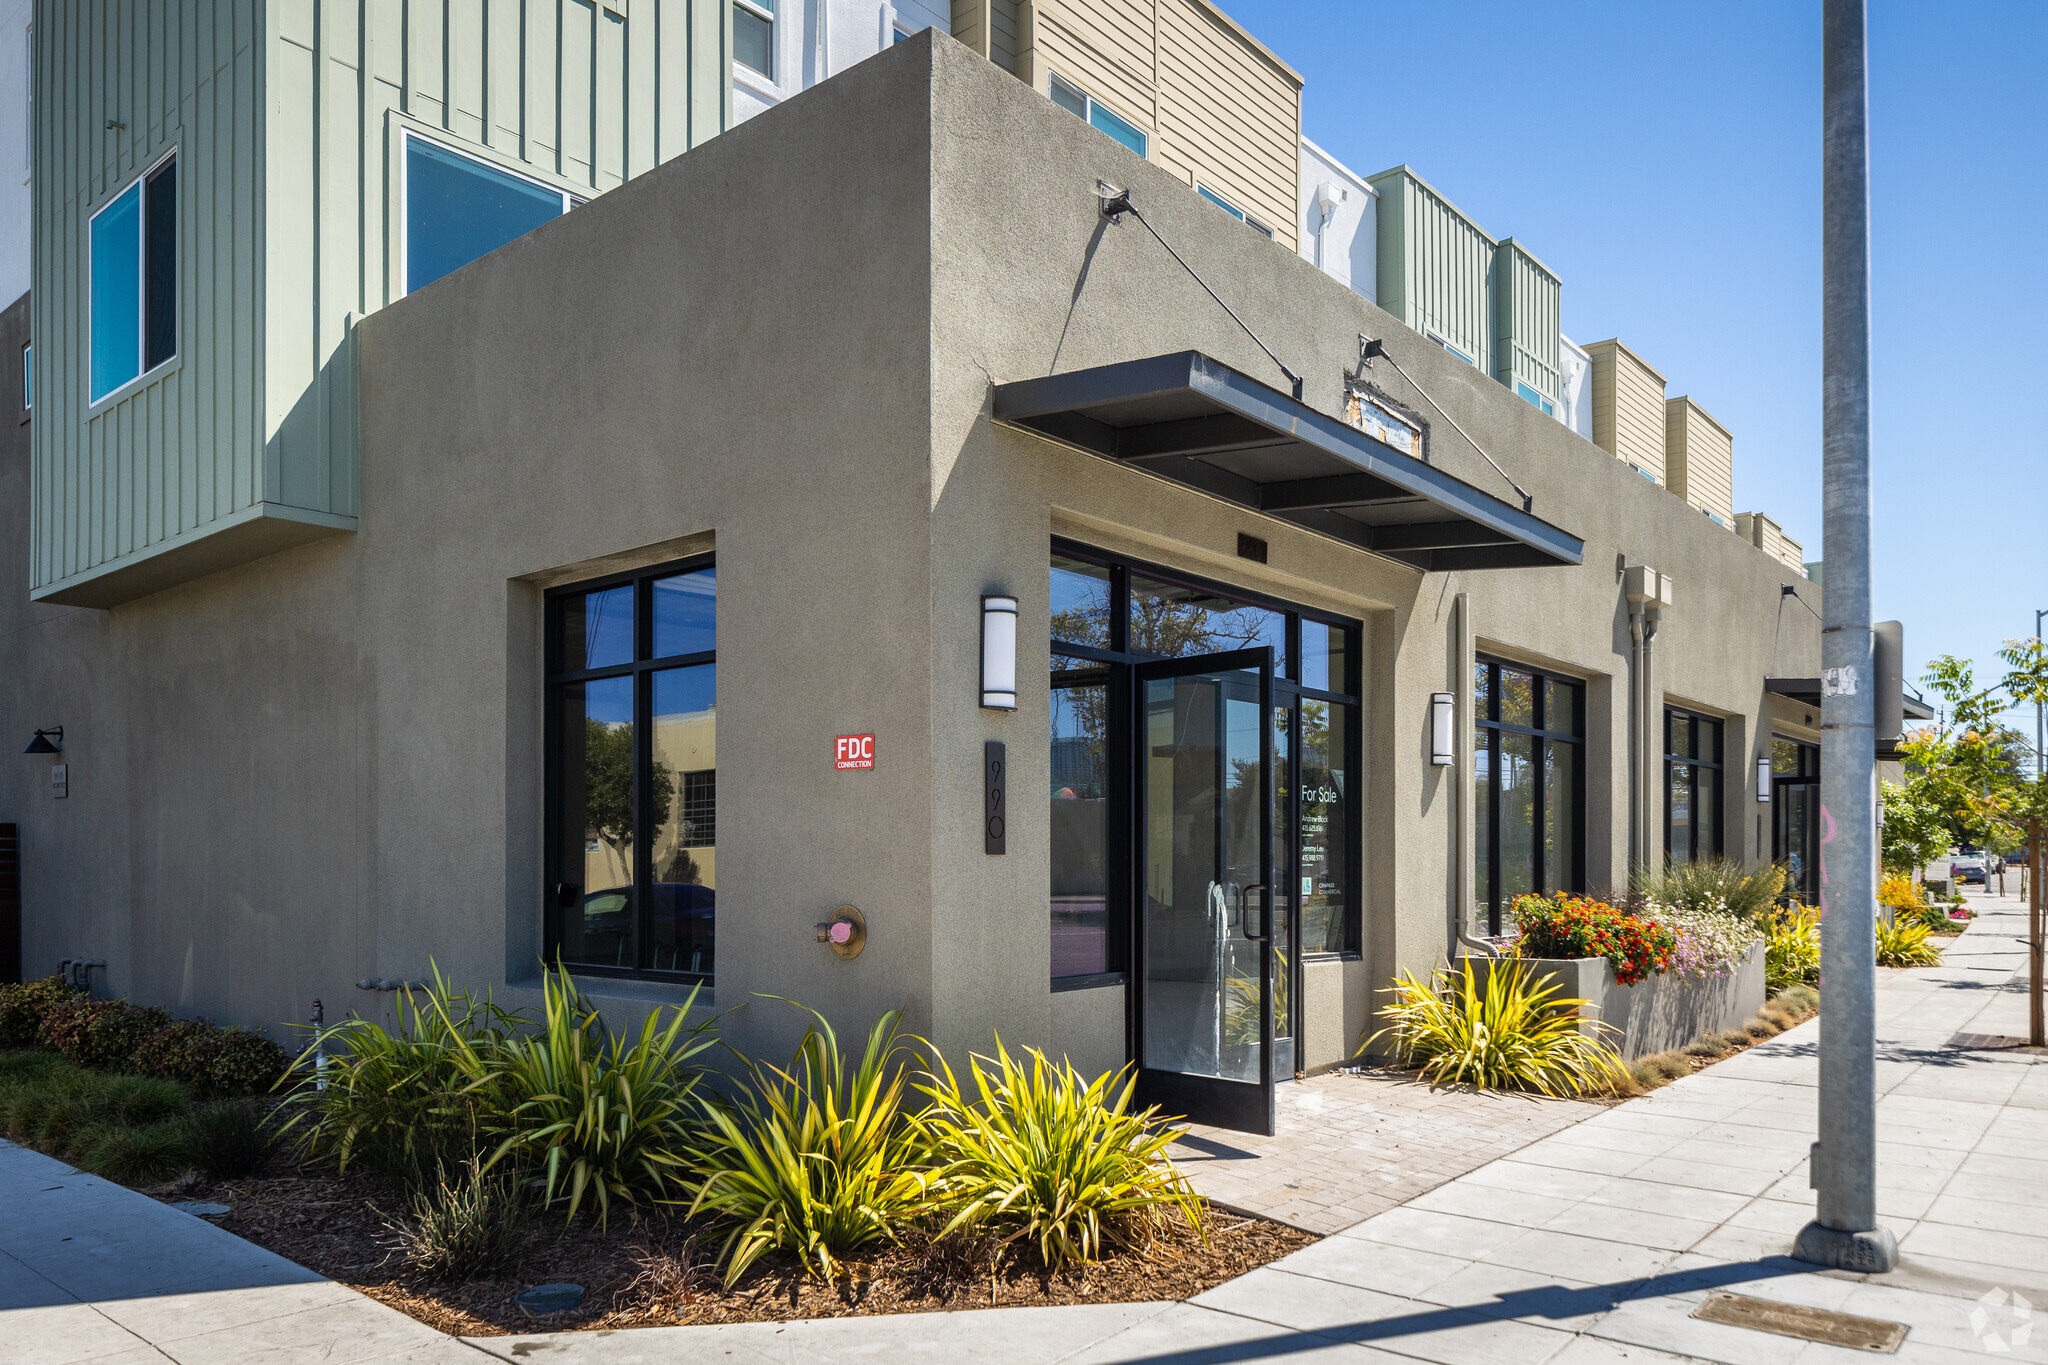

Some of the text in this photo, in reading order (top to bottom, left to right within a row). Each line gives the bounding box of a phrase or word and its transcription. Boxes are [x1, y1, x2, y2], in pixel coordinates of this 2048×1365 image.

[837, 736, 872, 760] FDC
[837, 760, 872, 769] CONNECTION
[988, 760, 1005, 839] 990
[1302, 785, 1337, 803] For Sale
[1302, 845, 1316, 854] Jeremy
